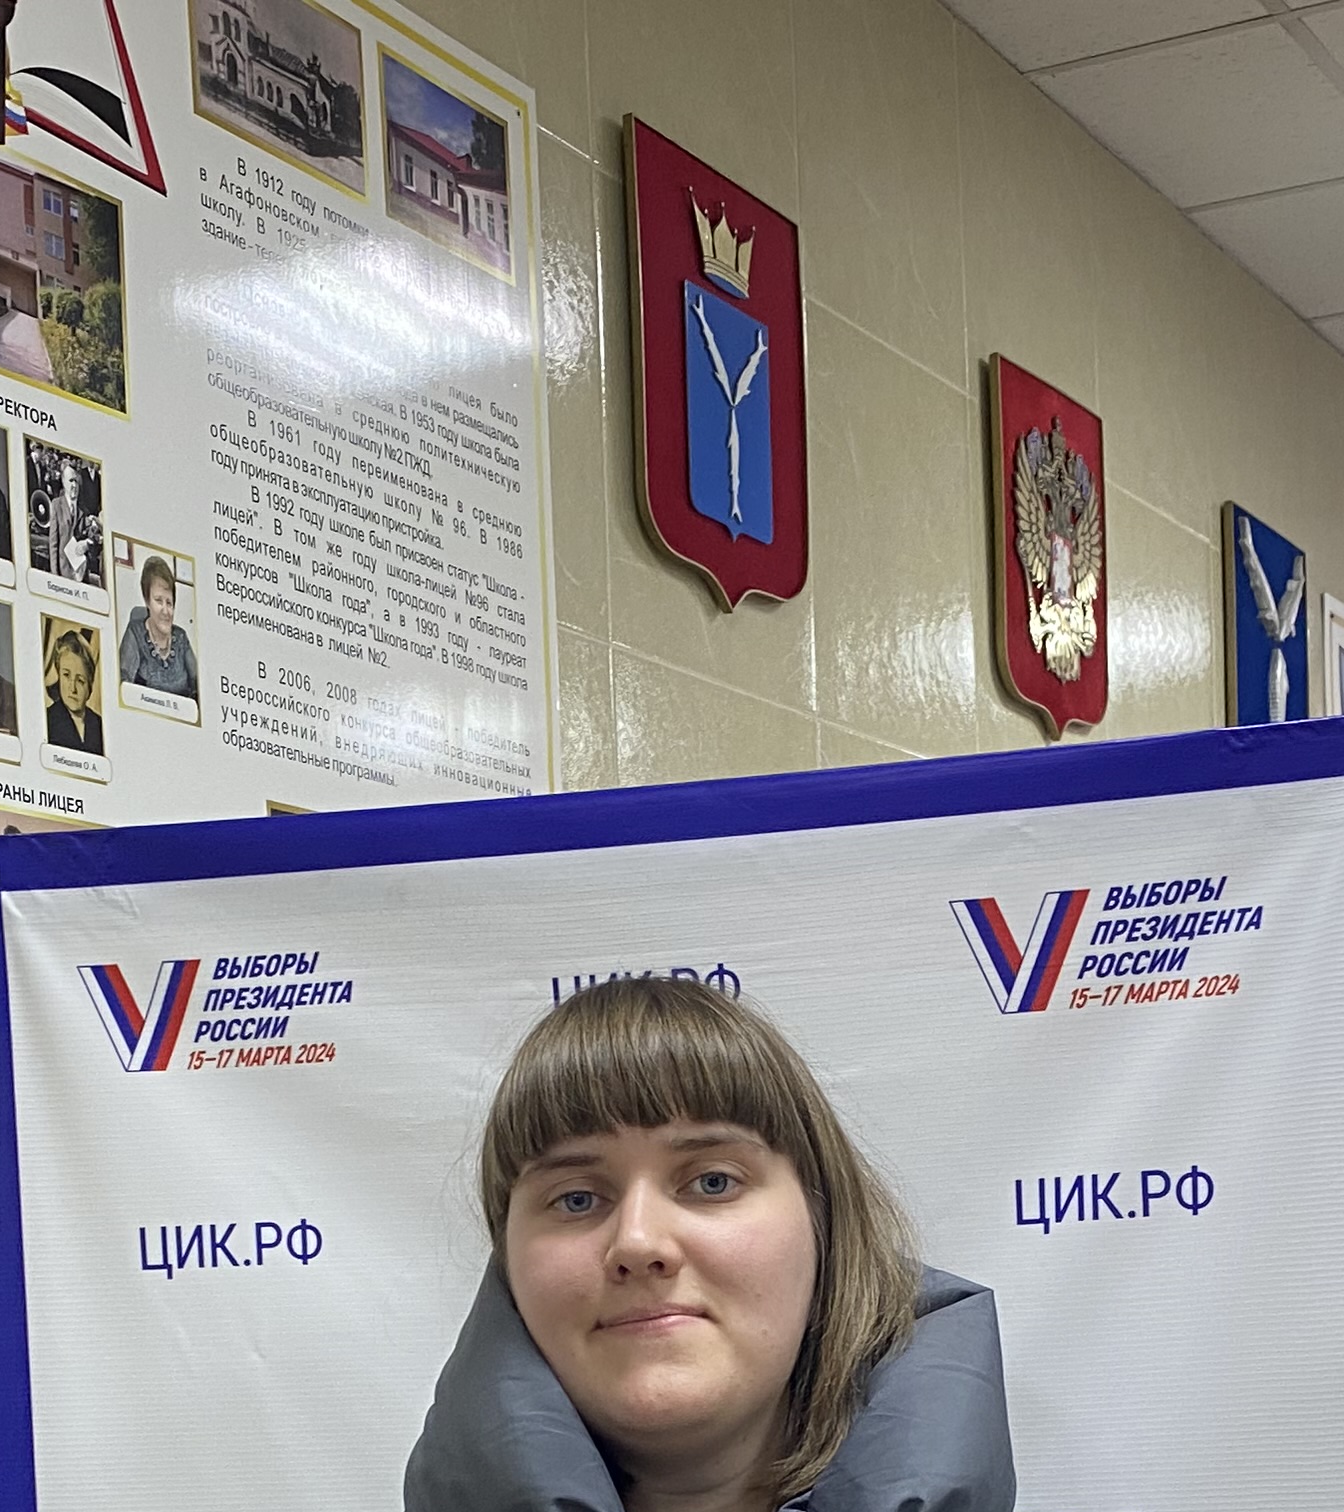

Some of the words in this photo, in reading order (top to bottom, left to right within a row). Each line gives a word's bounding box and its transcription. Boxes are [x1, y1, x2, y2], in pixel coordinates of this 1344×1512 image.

[200, 167, 207, 181] в
[219, 174, 320, 238] Агафоновском
[200, 192, 245, 227] школу.
[257, 216, 266, 235] В
[237, 157, 247, 176] В
[255, 168, 284, 197] 1912
[291, 188, 317, 216] году
[210, 424, 373, 498] общеобразовательную
[384, 493, 422, 522] школу
[432, 508, 444, 526] №
[453, 517, 472, 538] 96.
[480, 528, 487, 544] В
[497, 536, 523, 559] 1986
[211, 449, 238, 474] году
[240, 460, 290, 490] принята
[292, 480, 299, 493] в
[301, 484, 380, 525] эксплуатацию
[382, 514, 444, 550] пристройка.
[248, 410, 256, 427] В
[270, 420, 301, 446] 1961
[313, 440, 341, 465] году
[352, 456, 448, 506] переименована
[457, 500, 463, 513] в
[472, 507, 522, 537] среднюю
[251, 485, 260, 503] В
[266, 491, 294, 517] 1992
[299, 507, 324, 531] году
[329, 518, 365, 542] школе
[369, 530, 391, 552] был
[396, 543, 444, 573] присвоен
[447, 564, 479, 587] статус
[214, 526, 301, 567] победителем
[312, 560, 378, 597] районного,
[387, 587, 446, 619] городского
[455, 612, 461, 625] и
[469, 616, 527, 647] областного
[274, 518, 282, 536] В
[294, 529, 316, 548] том
[327, 541, 342, 558] же
[352, 551, 377, 574] году
[387, 563, 457, 600] школа-лицей
[465, 589, 489, 612] №96
[497, 605, 525, 626] стала
[215, 552, 278, 584] конкурсов
[384, 608, 391, 622] а
[399, 614, 406, 627] в
[415, 617, 439, 639] 1993
[448, 631, 469, 652] году
[489, 643, 527, 669] лауреат
[216, 573, 314, 620] Всероссийского
[316, 609, 367, 637] конкурса
[441, 648, 449, 664] В
[451, 652, 475, 673] 1998
[475, 662, 497, 684] году
[498, 672, 528, 691] школа
[218, 602, 315, 645] переименована
[316, 633, 323, 648] в
[328, 638, 364, 660] лицей
[368, 646, 391, 669] №2.
[39, 791, 84, 814] ЛИЦЕЯ
[1102, 876, 1228, 912] ВЫБОРЫ
[1089, 906, 1264, 946] ПРЕЗИДЕНТА
[213, 952, 319, 981] ВЫБОРЫ
[1077, 947, 1190, 980] РОССИИ
[1124, 978, 1190, 1005] МАРТА
[1194, 974, 1240, 998] 2024
[203, 979, 354, 1013] ПРЕЗИДЕНТА
[194, 1016, 289, 1043] РОССИИ
[235, 1045, 292, 1070] МАРТА
[294, 1043, 337, 1066] 2024
[1014, 1165, 1215, 1235] ЦИК.РФ
[139, 1218, 324, 1280] ЦИК.РФ
